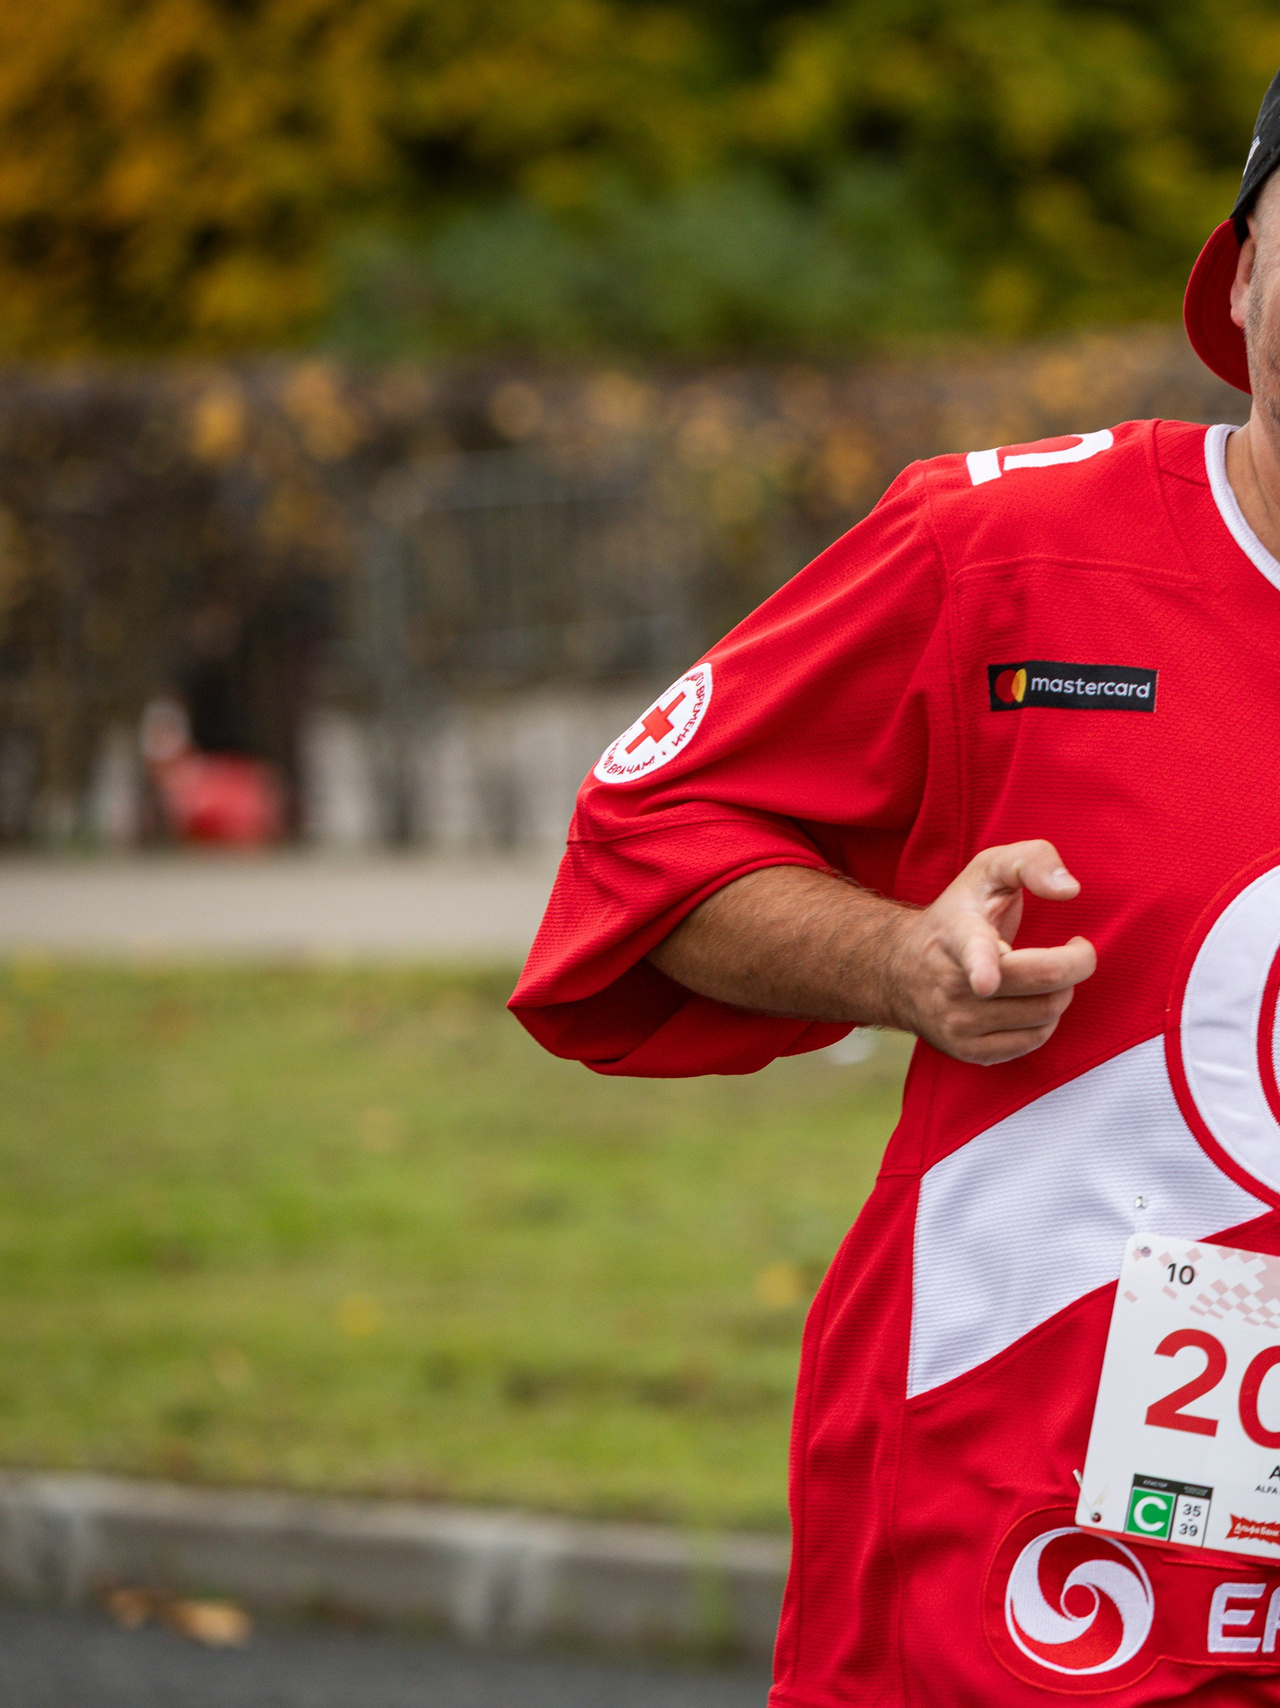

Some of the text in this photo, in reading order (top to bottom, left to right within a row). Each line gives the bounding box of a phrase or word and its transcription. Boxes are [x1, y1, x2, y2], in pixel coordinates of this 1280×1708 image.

[1030, 674, 1151, 700] mastercard
[1166, 1261, 1196, 1286] 10
[1254, 1484, 1279, 1495] ALFA
[1183, 1503, 1202, 1518] 35
[1179, 1522, 1199, 1537] 39
